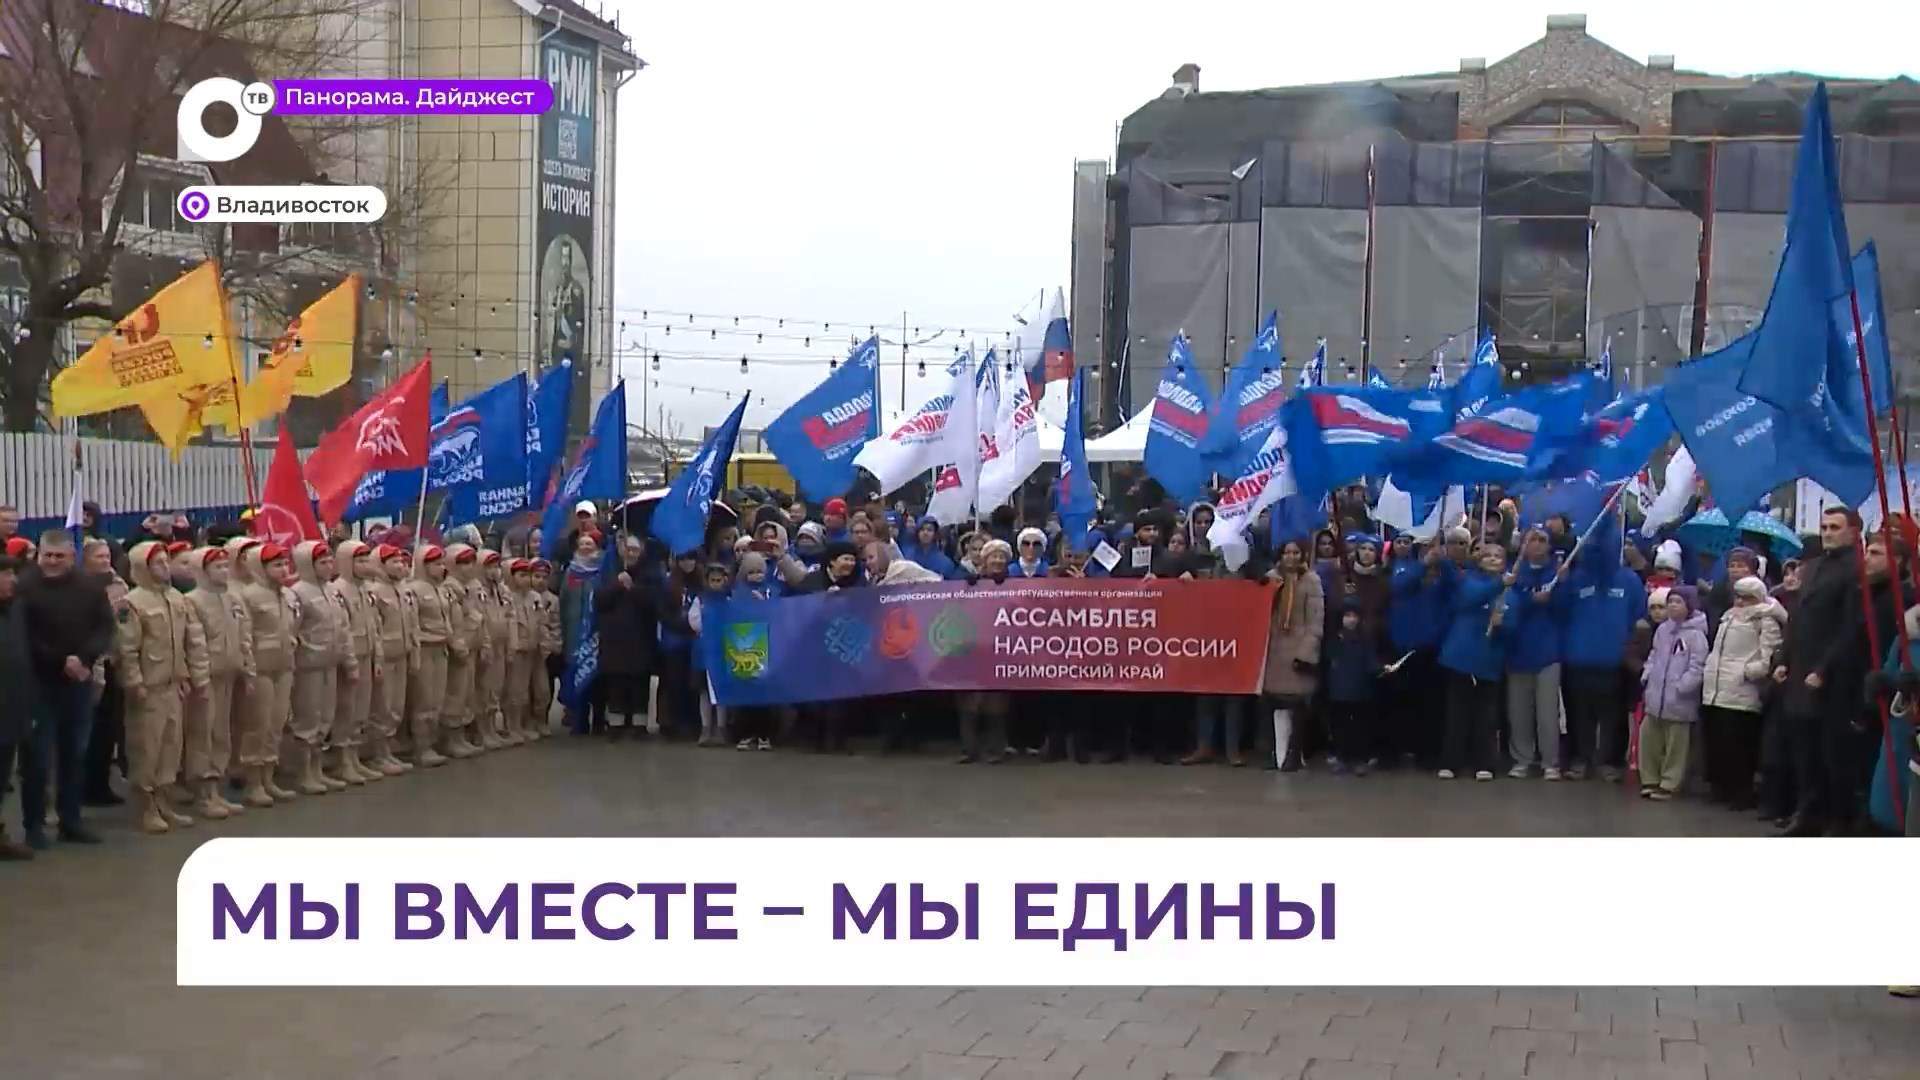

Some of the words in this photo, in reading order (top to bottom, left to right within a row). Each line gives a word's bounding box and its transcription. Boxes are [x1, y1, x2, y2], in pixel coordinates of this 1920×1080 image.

[542, 181, 591, 217] ИСТОРИЯ
[993, 607, 1158, 628] АССАМБЛЕЯ
[994, 635, 1119, 660] НАРОДОВ
[1127, 637, 1238, 658] РОССИИ
[995, 663, 1115, 680] ПРИМОРСКИЙ
[1119, 663, 1165, 680] КРАЙ
